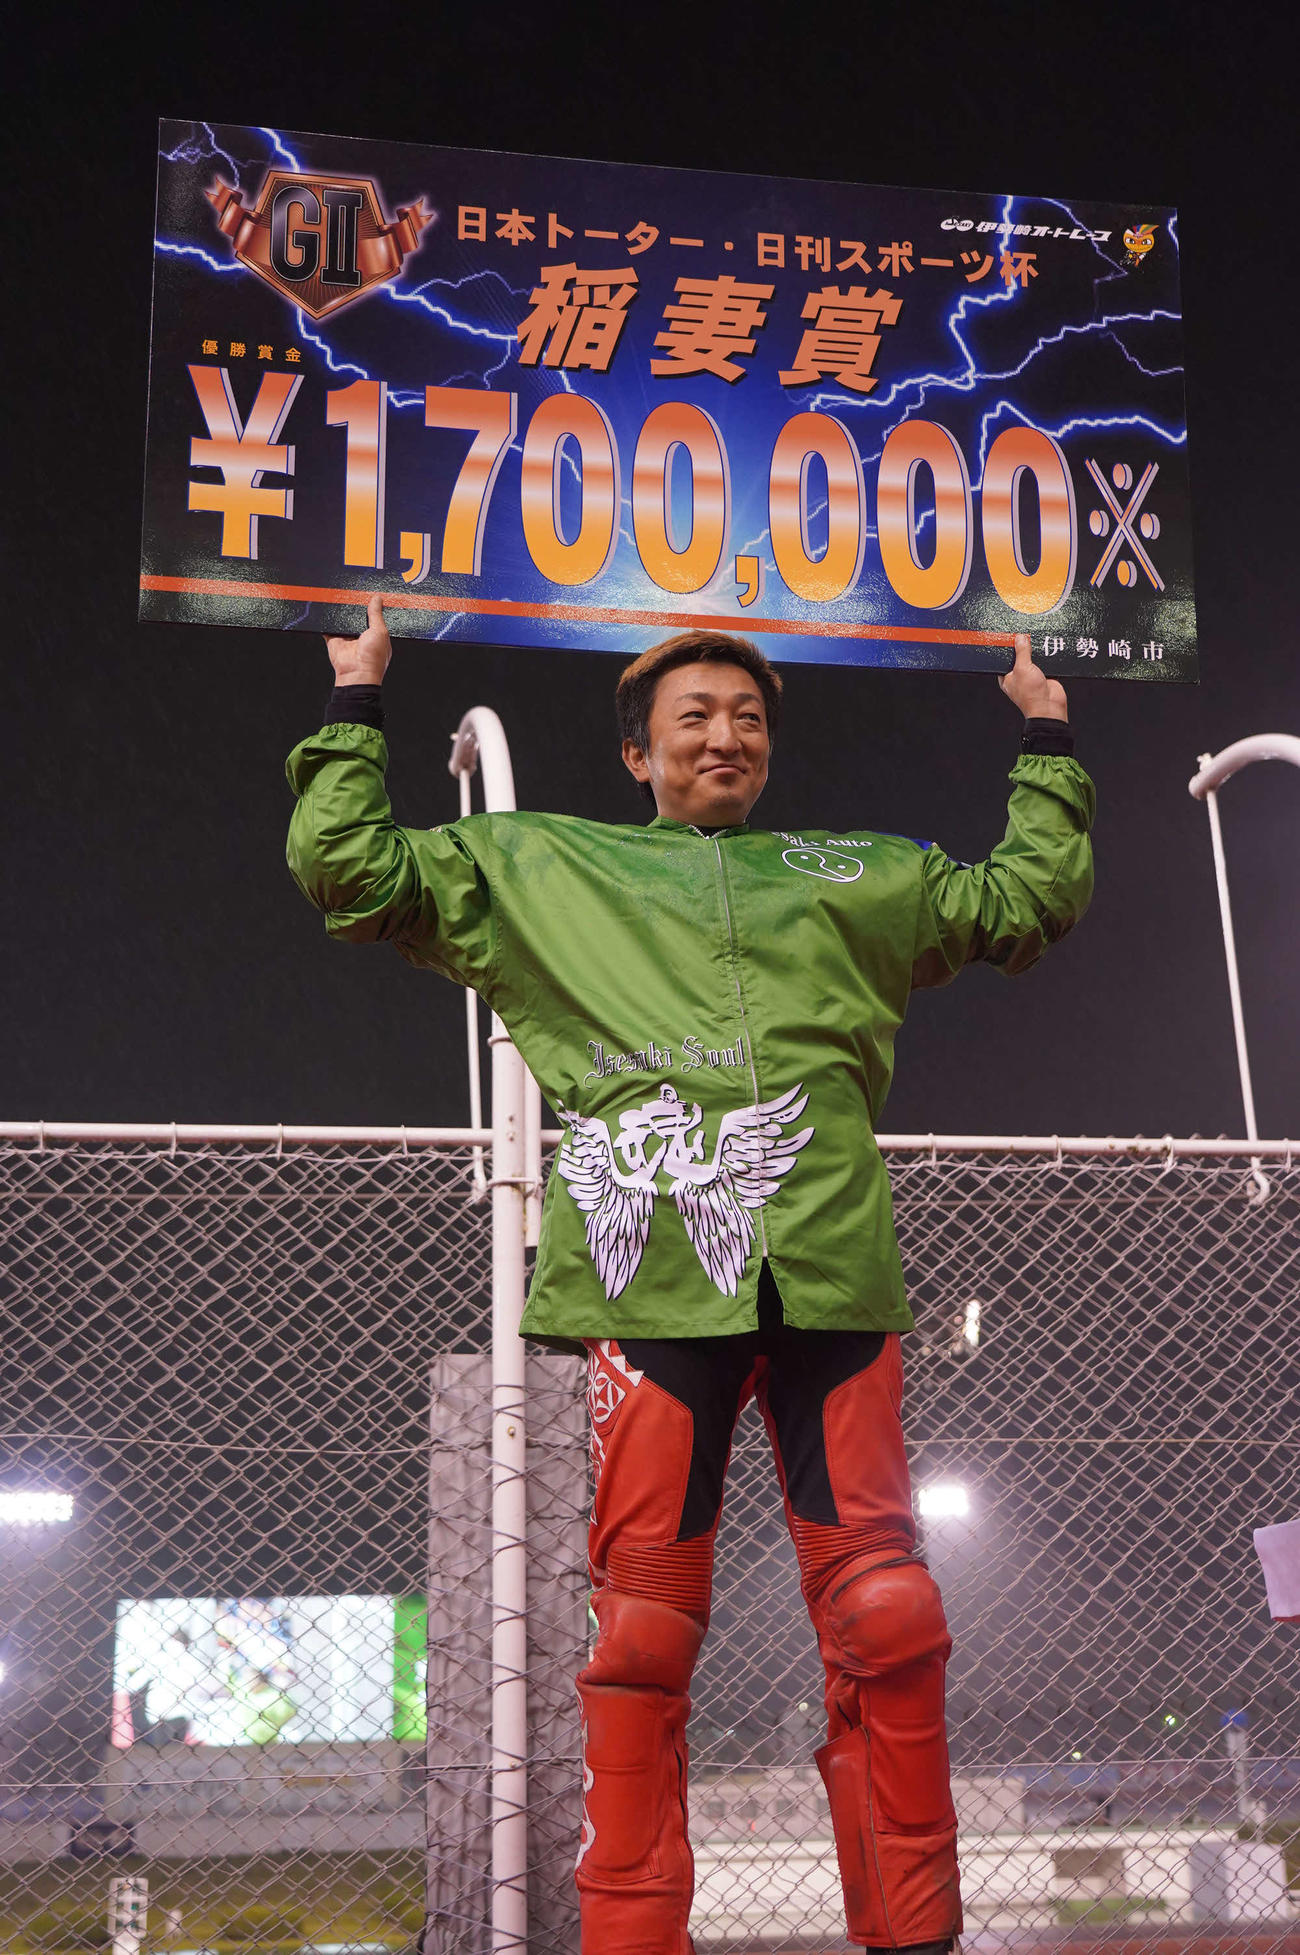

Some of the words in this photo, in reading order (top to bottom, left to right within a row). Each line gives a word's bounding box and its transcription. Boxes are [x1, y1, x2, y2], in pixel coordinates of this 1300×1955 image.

[457, 205, 1040, 288] 日本トーター・日刊スポーツ杯
[516, 262, 904, 393] 稲妻賞
[202, 339, 301, 362] 優勝賞金
[1042, 635, 1164, 661] 伊勢崎市
[681, 1035, 747, 1074] Soul
